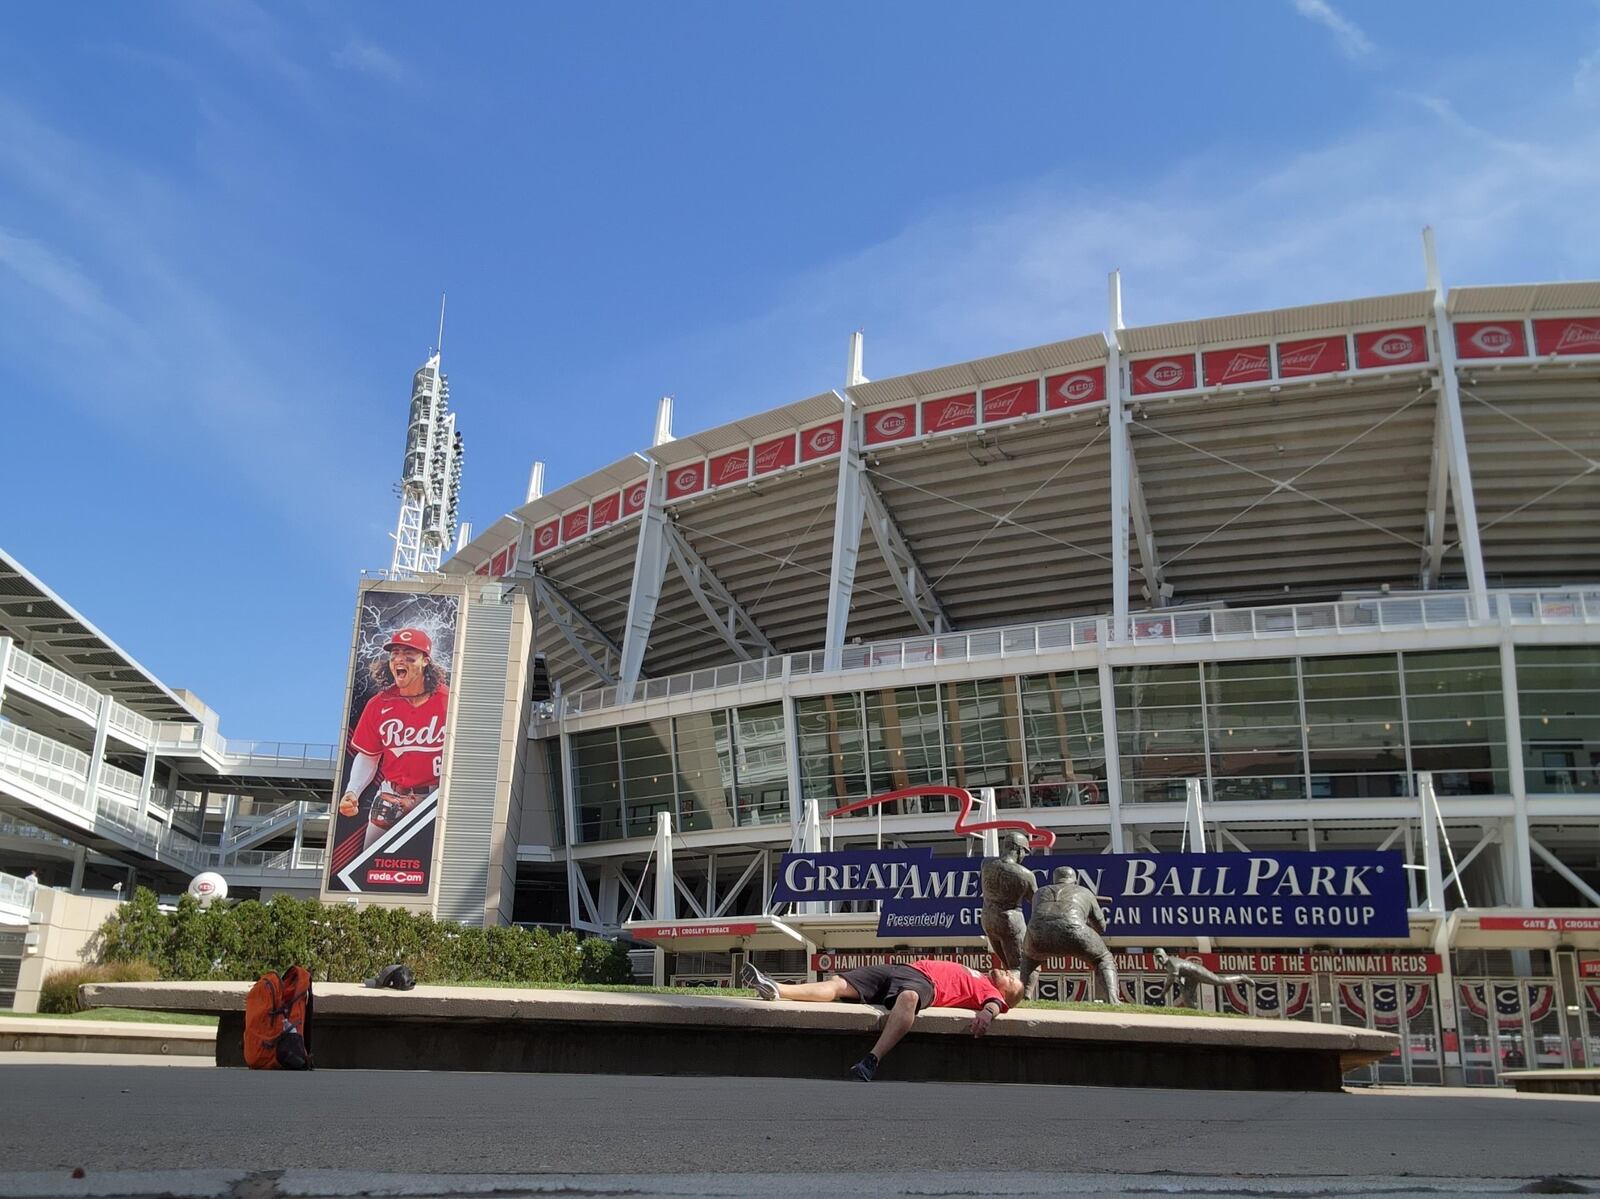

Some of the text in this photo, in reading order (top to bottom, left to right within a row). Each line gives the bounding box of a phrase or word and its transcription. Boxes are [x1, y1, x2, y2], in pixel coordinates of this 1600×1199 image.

[379, 715, 446, 746] Reds
[374, 858, 421, 869] TICKETS
[785, 858, 907, 892] GREAT
[1121, 859, 1235, 896] BALL
[1243, 857, 1373, 896] PARK
[886, 912, 939, 927] Presented
[1152, 906, 1283, 925] INSURANCE
[1295, 906, 1375, 925] GROUP
[1523, 918, 1600, 929] GATE A CROSLE
[671, 927, 678, 937] A
[706, 926, 730, 934] TERRACE
[1219, 954, 1256, 971] HOME
[1260, 955, 1277, 971] OF
[1280, 955, 1305, 972] THE
[1310, 955, 1387, 972] CINCINNATI
[1392, 955, 1428, 972] REDS
